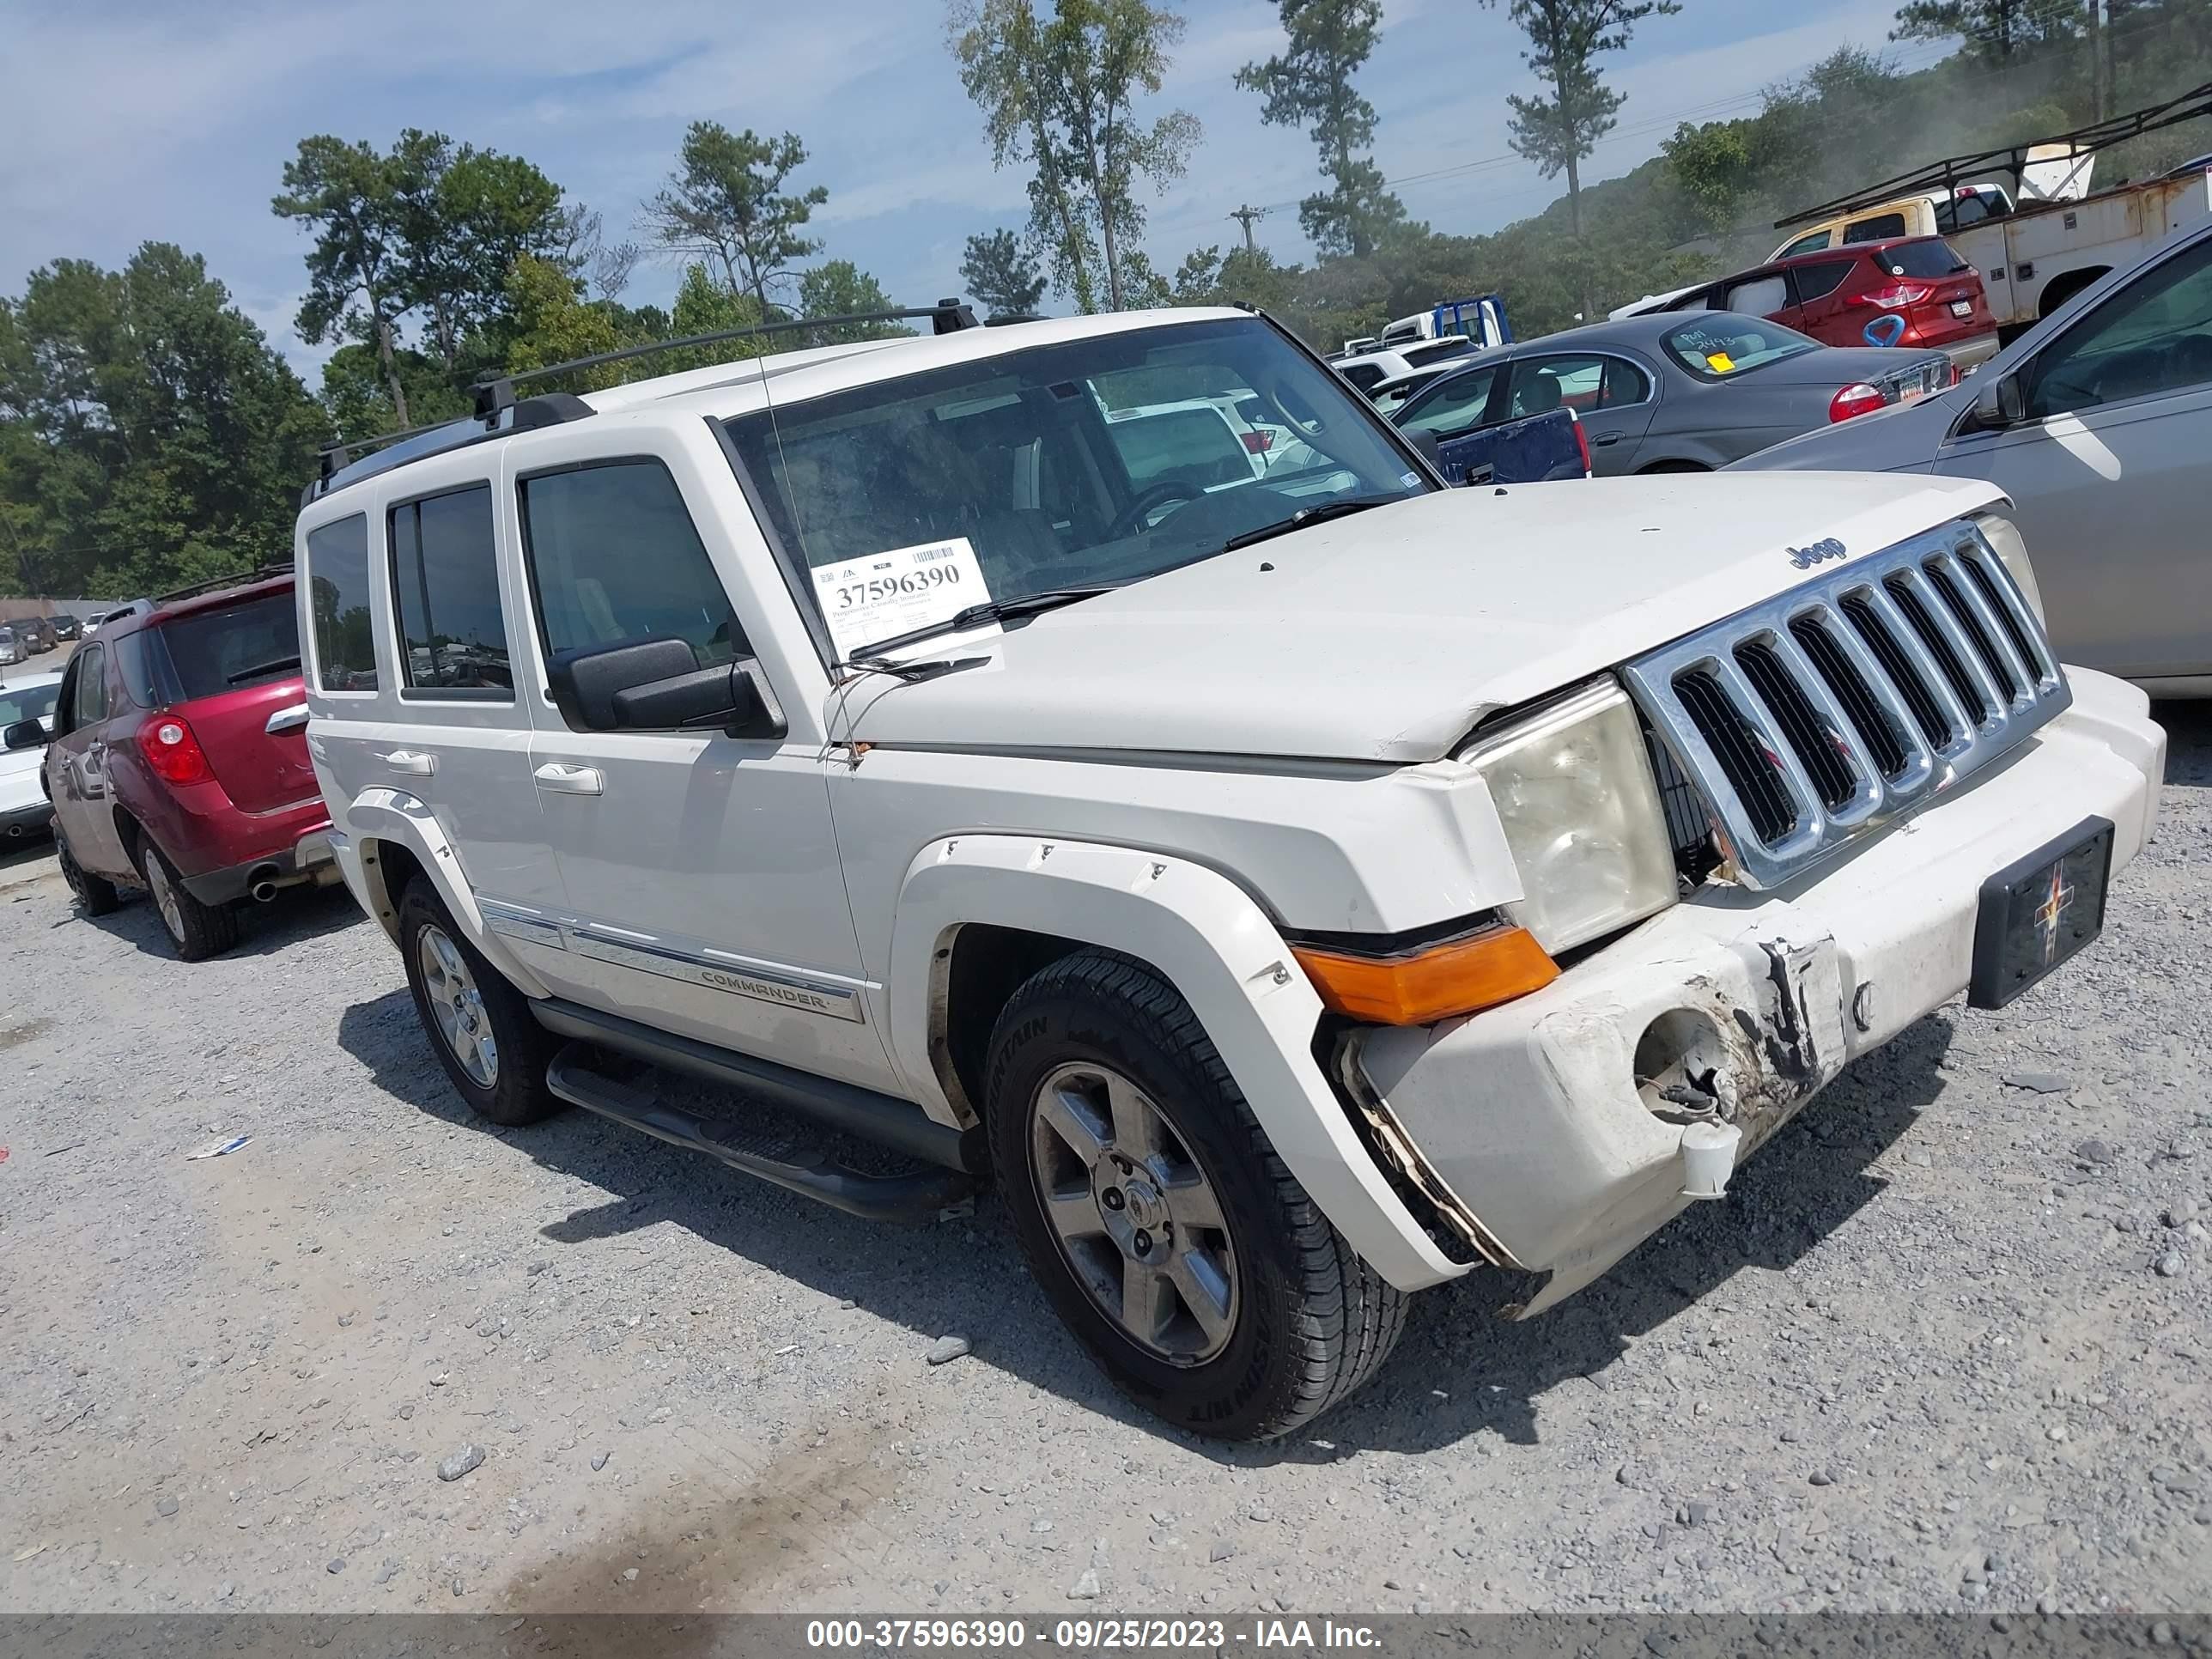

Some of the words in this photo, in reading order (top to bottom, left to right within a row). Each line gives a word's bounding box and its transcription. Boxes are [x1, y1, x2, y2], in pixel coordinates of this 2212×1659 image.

[1697, 337, 1735, 349] 2493
[1784, 537, 1847, 570] Jeep
[836, 564, 960, 608] 37596390
[701, 971, 828, 1009] COMMANDER
